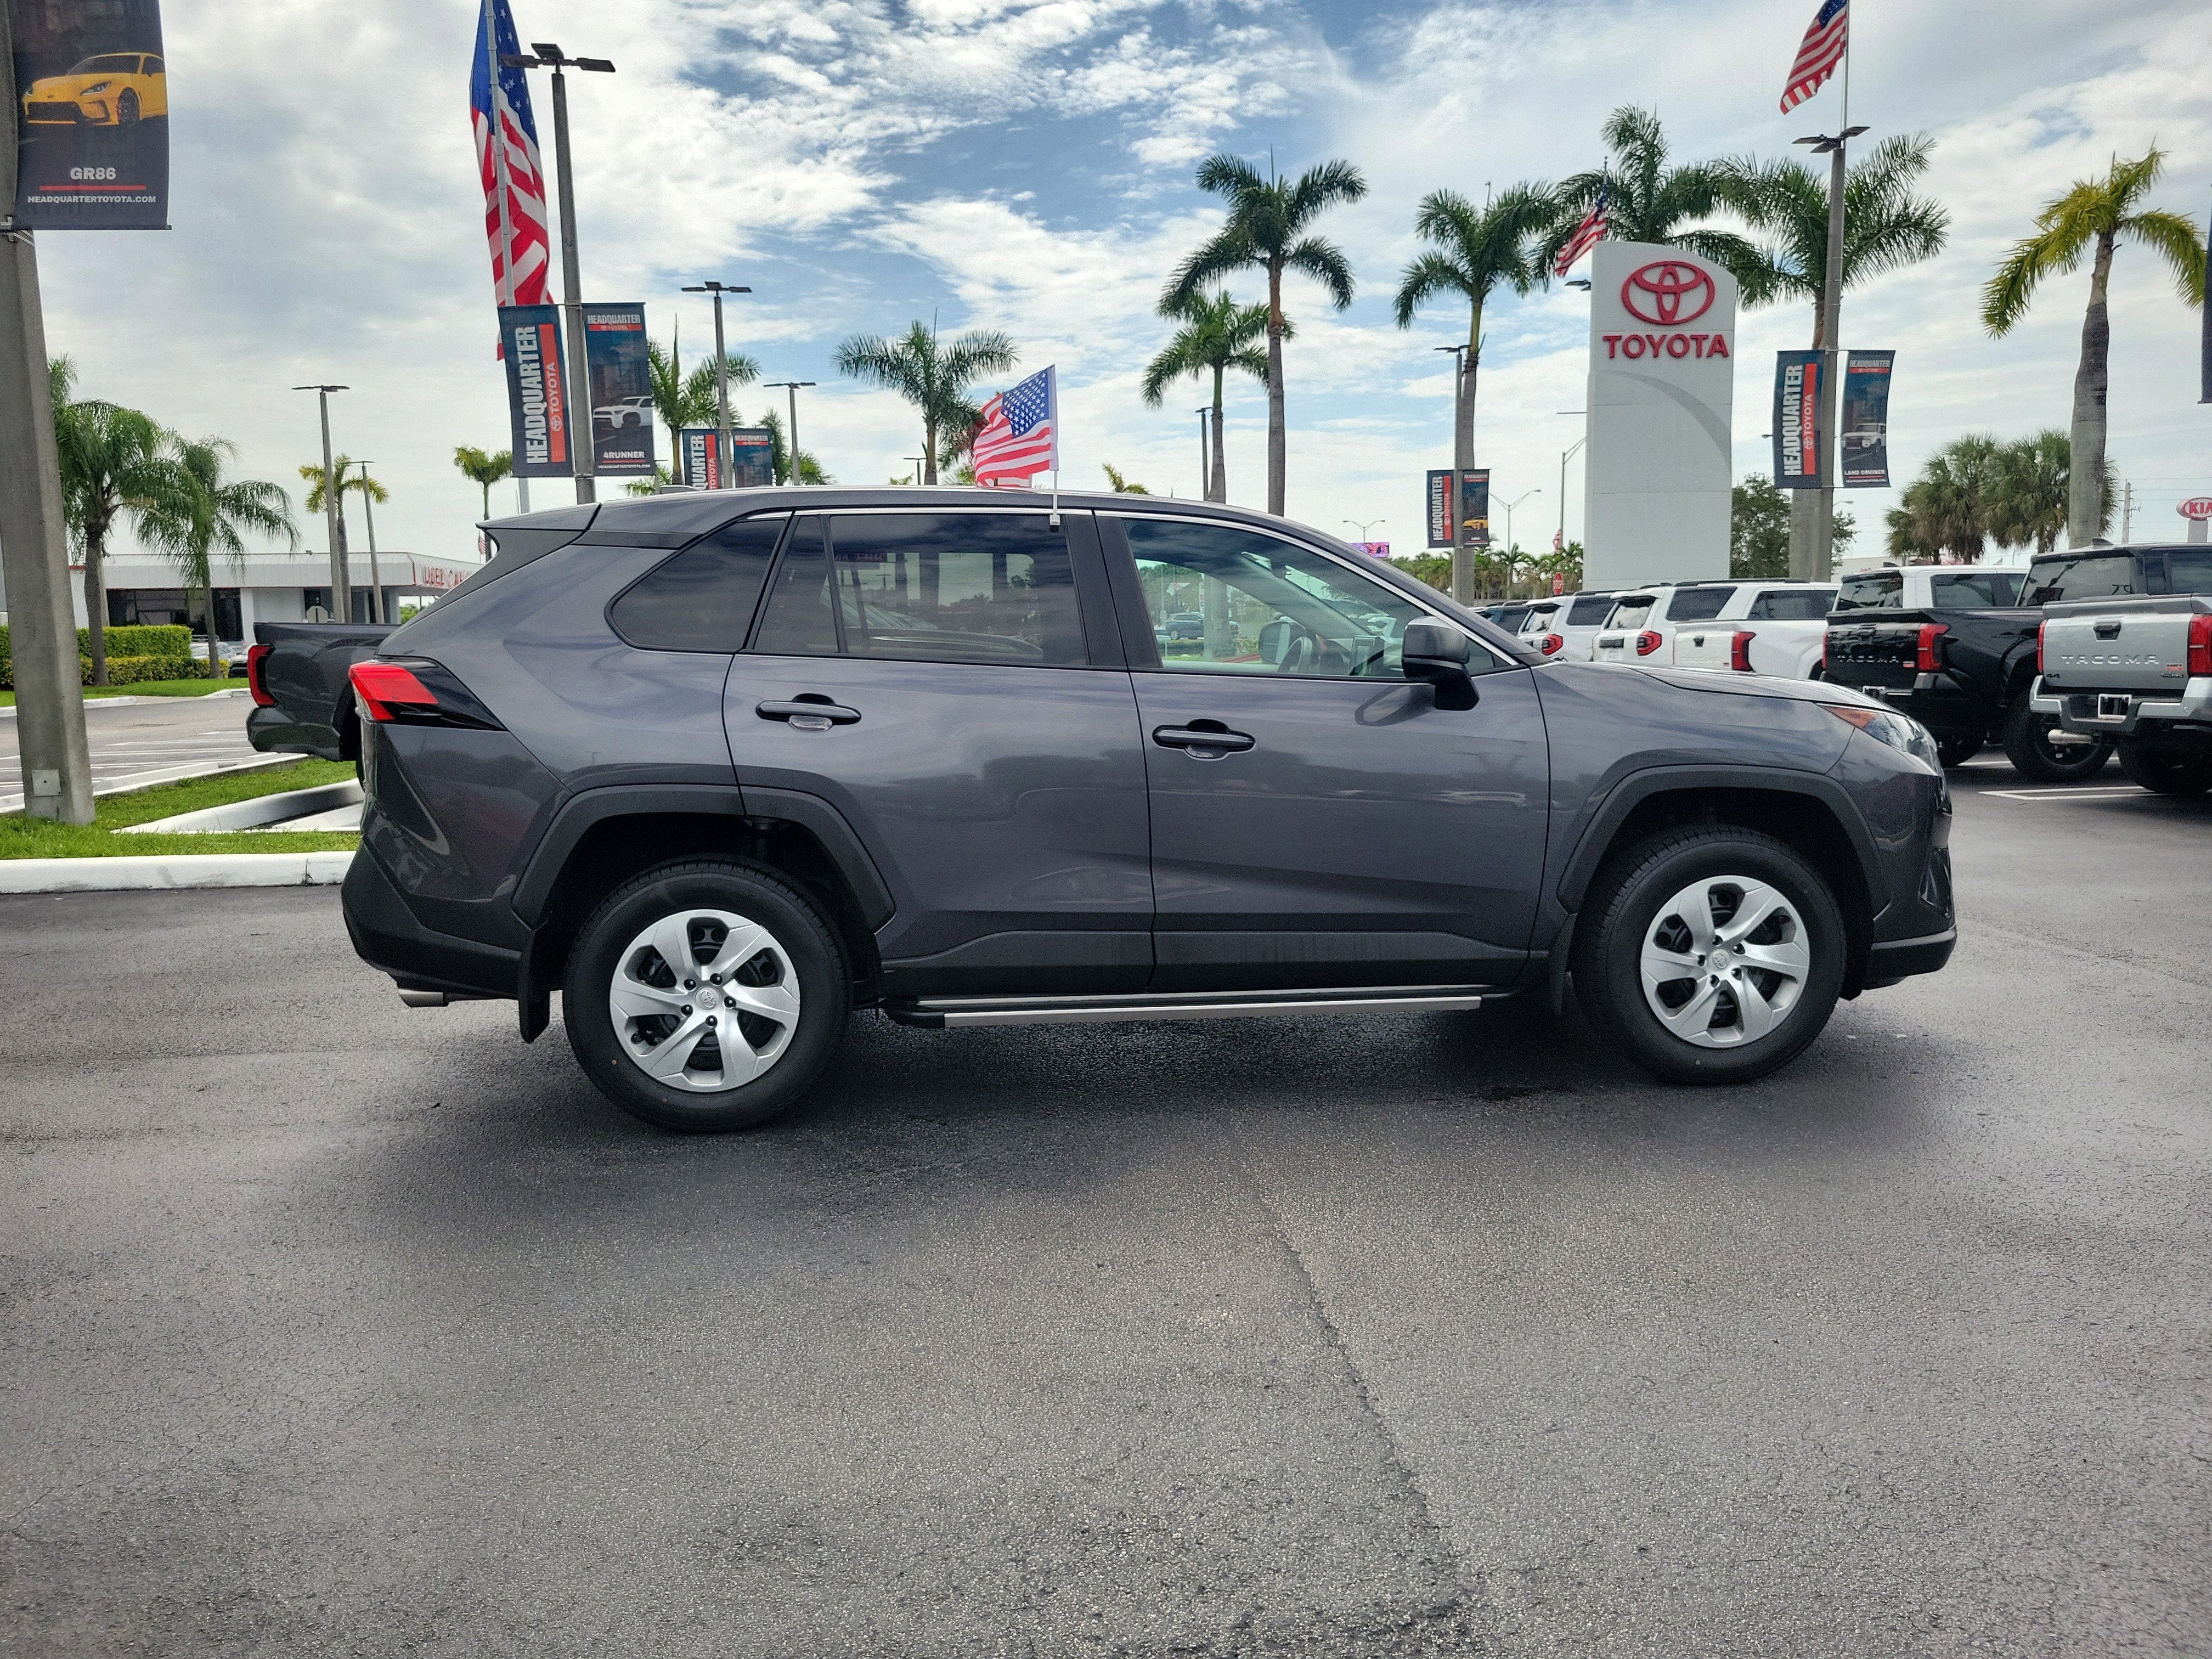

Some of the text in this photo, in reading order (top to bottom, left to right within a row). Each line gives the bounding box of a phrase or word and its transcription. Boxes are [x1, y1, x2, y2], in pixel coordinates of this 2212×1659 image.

[70, 167, 117, 180] GR86
[27, 195, 156, 204] HEADQUARTERTOYOTA.COM
[587, 314, 641, 325] HEADQUARTER
[1602, 334, 1729, 359] TOYOTA
[515, 326, 548, 464] HEADQUARTER
[546, 362, 562, 414] TOYOTA
[1782, 364, 1803, 476] HEADQUARTER
[1803, 394, 1813, 435] TOYOTA
[602, 450, 645, 459] 4RUNNER
[708, 457, 718, 489] TOYOTA
[1432, 476, 1444, 541] HEADQUARTER
[2061, 654, 2159, 664] TACOMA
